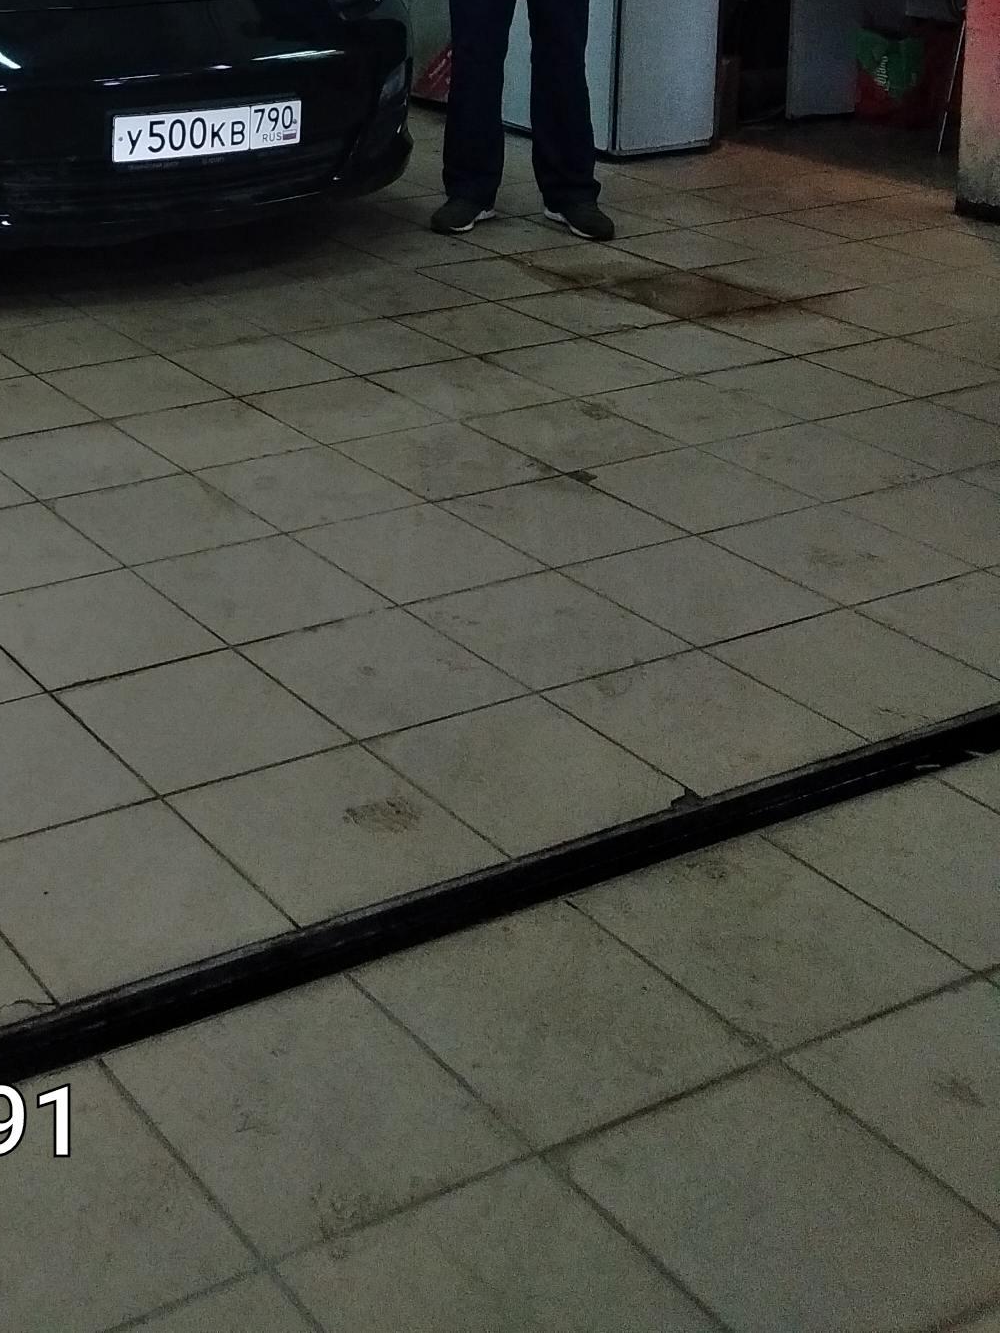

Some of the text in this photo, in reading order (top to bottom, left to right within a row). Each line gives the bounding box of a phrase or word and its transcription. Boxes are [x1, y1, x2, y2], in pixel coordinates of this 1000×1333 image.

[127, 105, 294, 155] У500КВ 790
[262, 133, 282, 143] RUS
